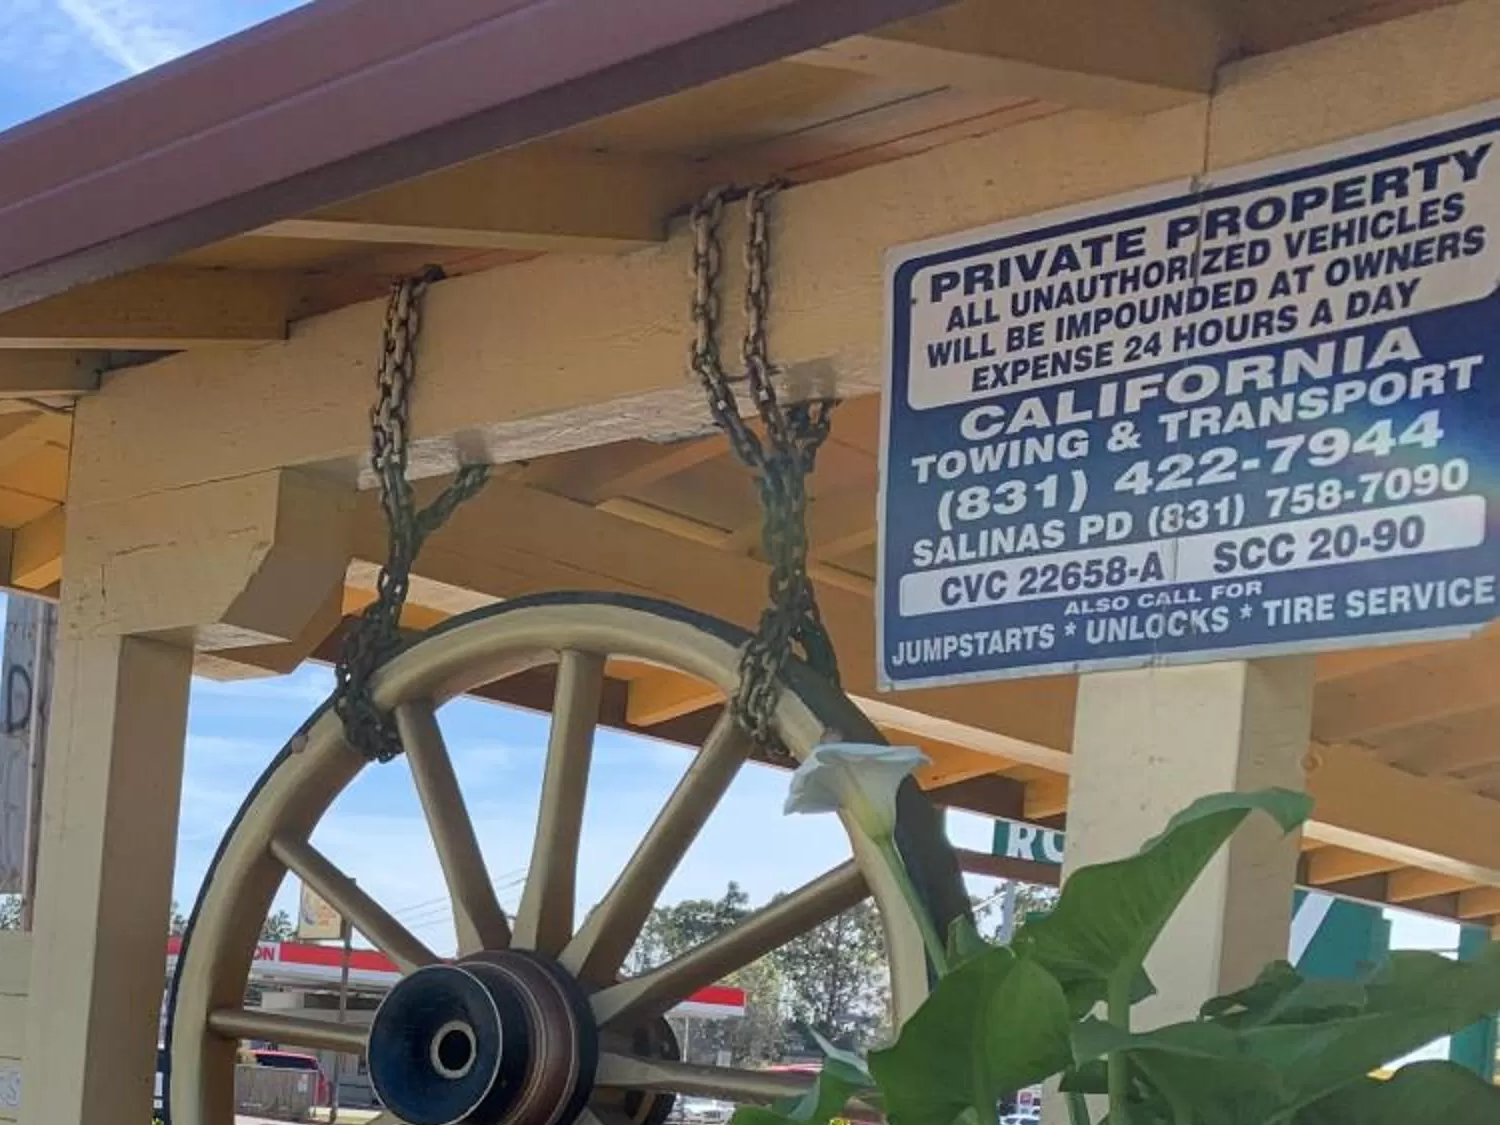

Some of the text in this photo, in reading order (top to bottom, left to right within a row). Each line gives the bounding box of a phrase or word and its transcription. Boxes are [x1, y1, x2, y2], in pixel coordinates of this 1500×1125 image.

[930, 142, 1492, 303] PRIVATE PROPERTY
[946, 192, 1465, 333] ALL UNAUTHORIZED VEHICLES
[927, 224, 1486, 368] WILL BE IMPOUNDED AT OWNERS
[971, 277, 1421, 392] EXPENSE 24 HOURS A DAY
[911, 355, 1484, 484] TOWING & TRANSPORT
[960, 326, 1423, 441] CALIFORNIA
[912, 457, 1470, 568] SALINAS PD (831) 758-7090
[937, 409, 1445, 532] (831) 422-7944
[940, 514, 1426, 606] CVC 22658-A SCC 20-90
[1063, 580, 1263, 616] ALSO CALL FOR
[891, 575, 1496, 667] JUMPSTARTS UNLOCKS TIRE SERVICE
